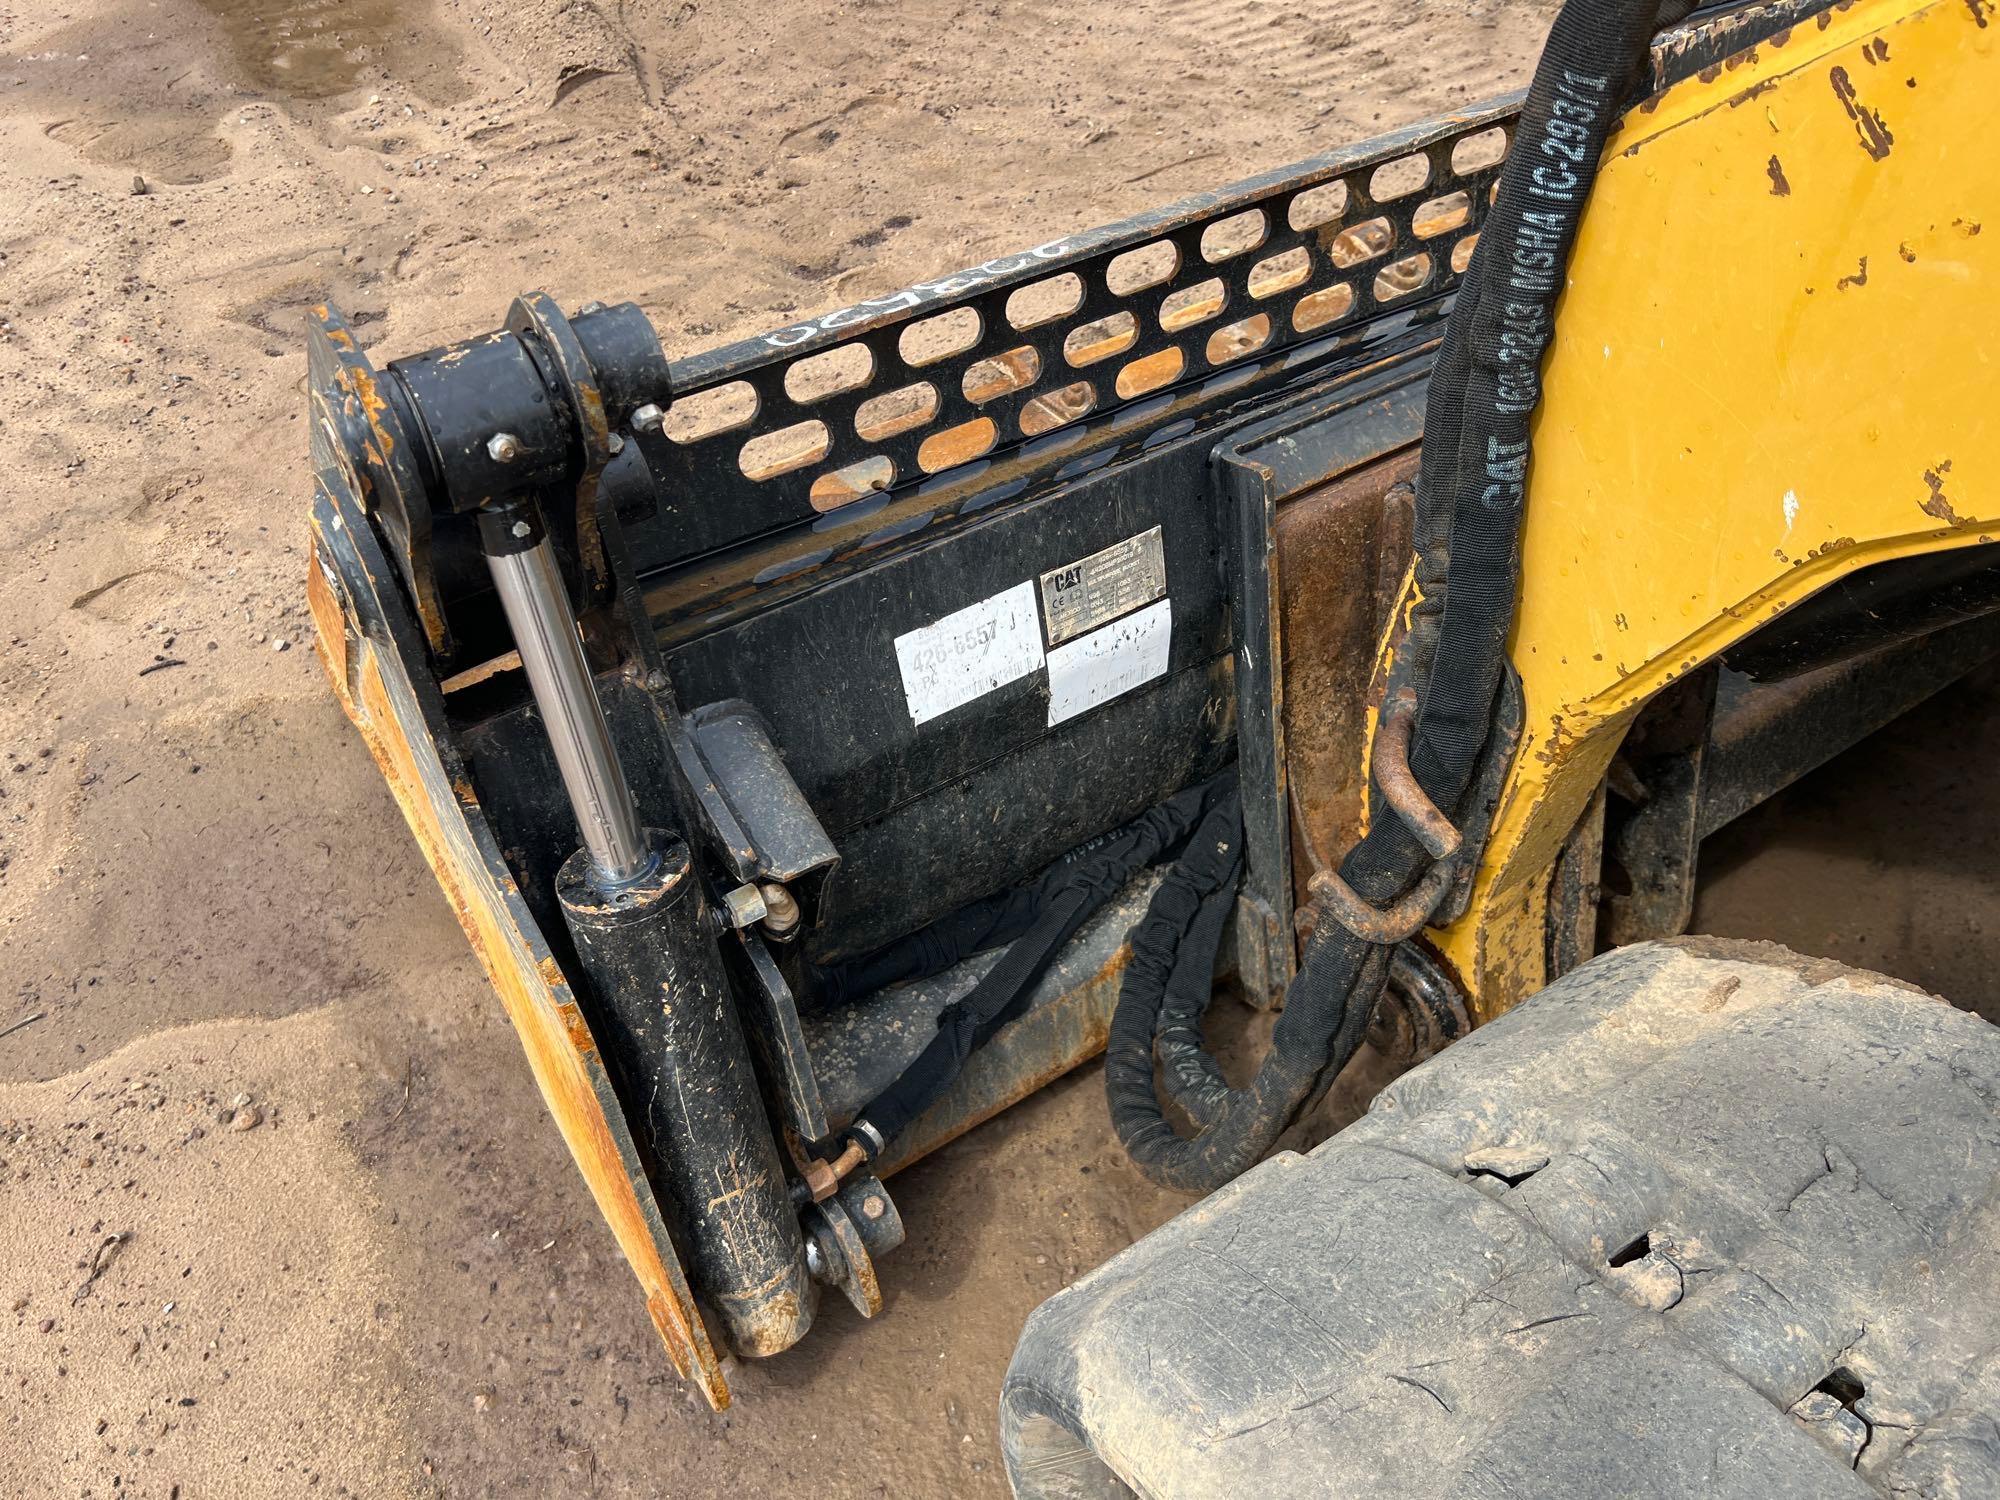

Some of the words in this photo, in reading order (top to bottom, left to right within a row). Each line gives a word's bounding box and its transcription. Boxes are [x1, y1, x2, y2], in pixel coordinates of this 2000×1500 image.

[1482, 436, 1529, 509] CAT
[1510, 211, 1566, 291] MSHA
[1054, 565, 1082, 592] CAT
